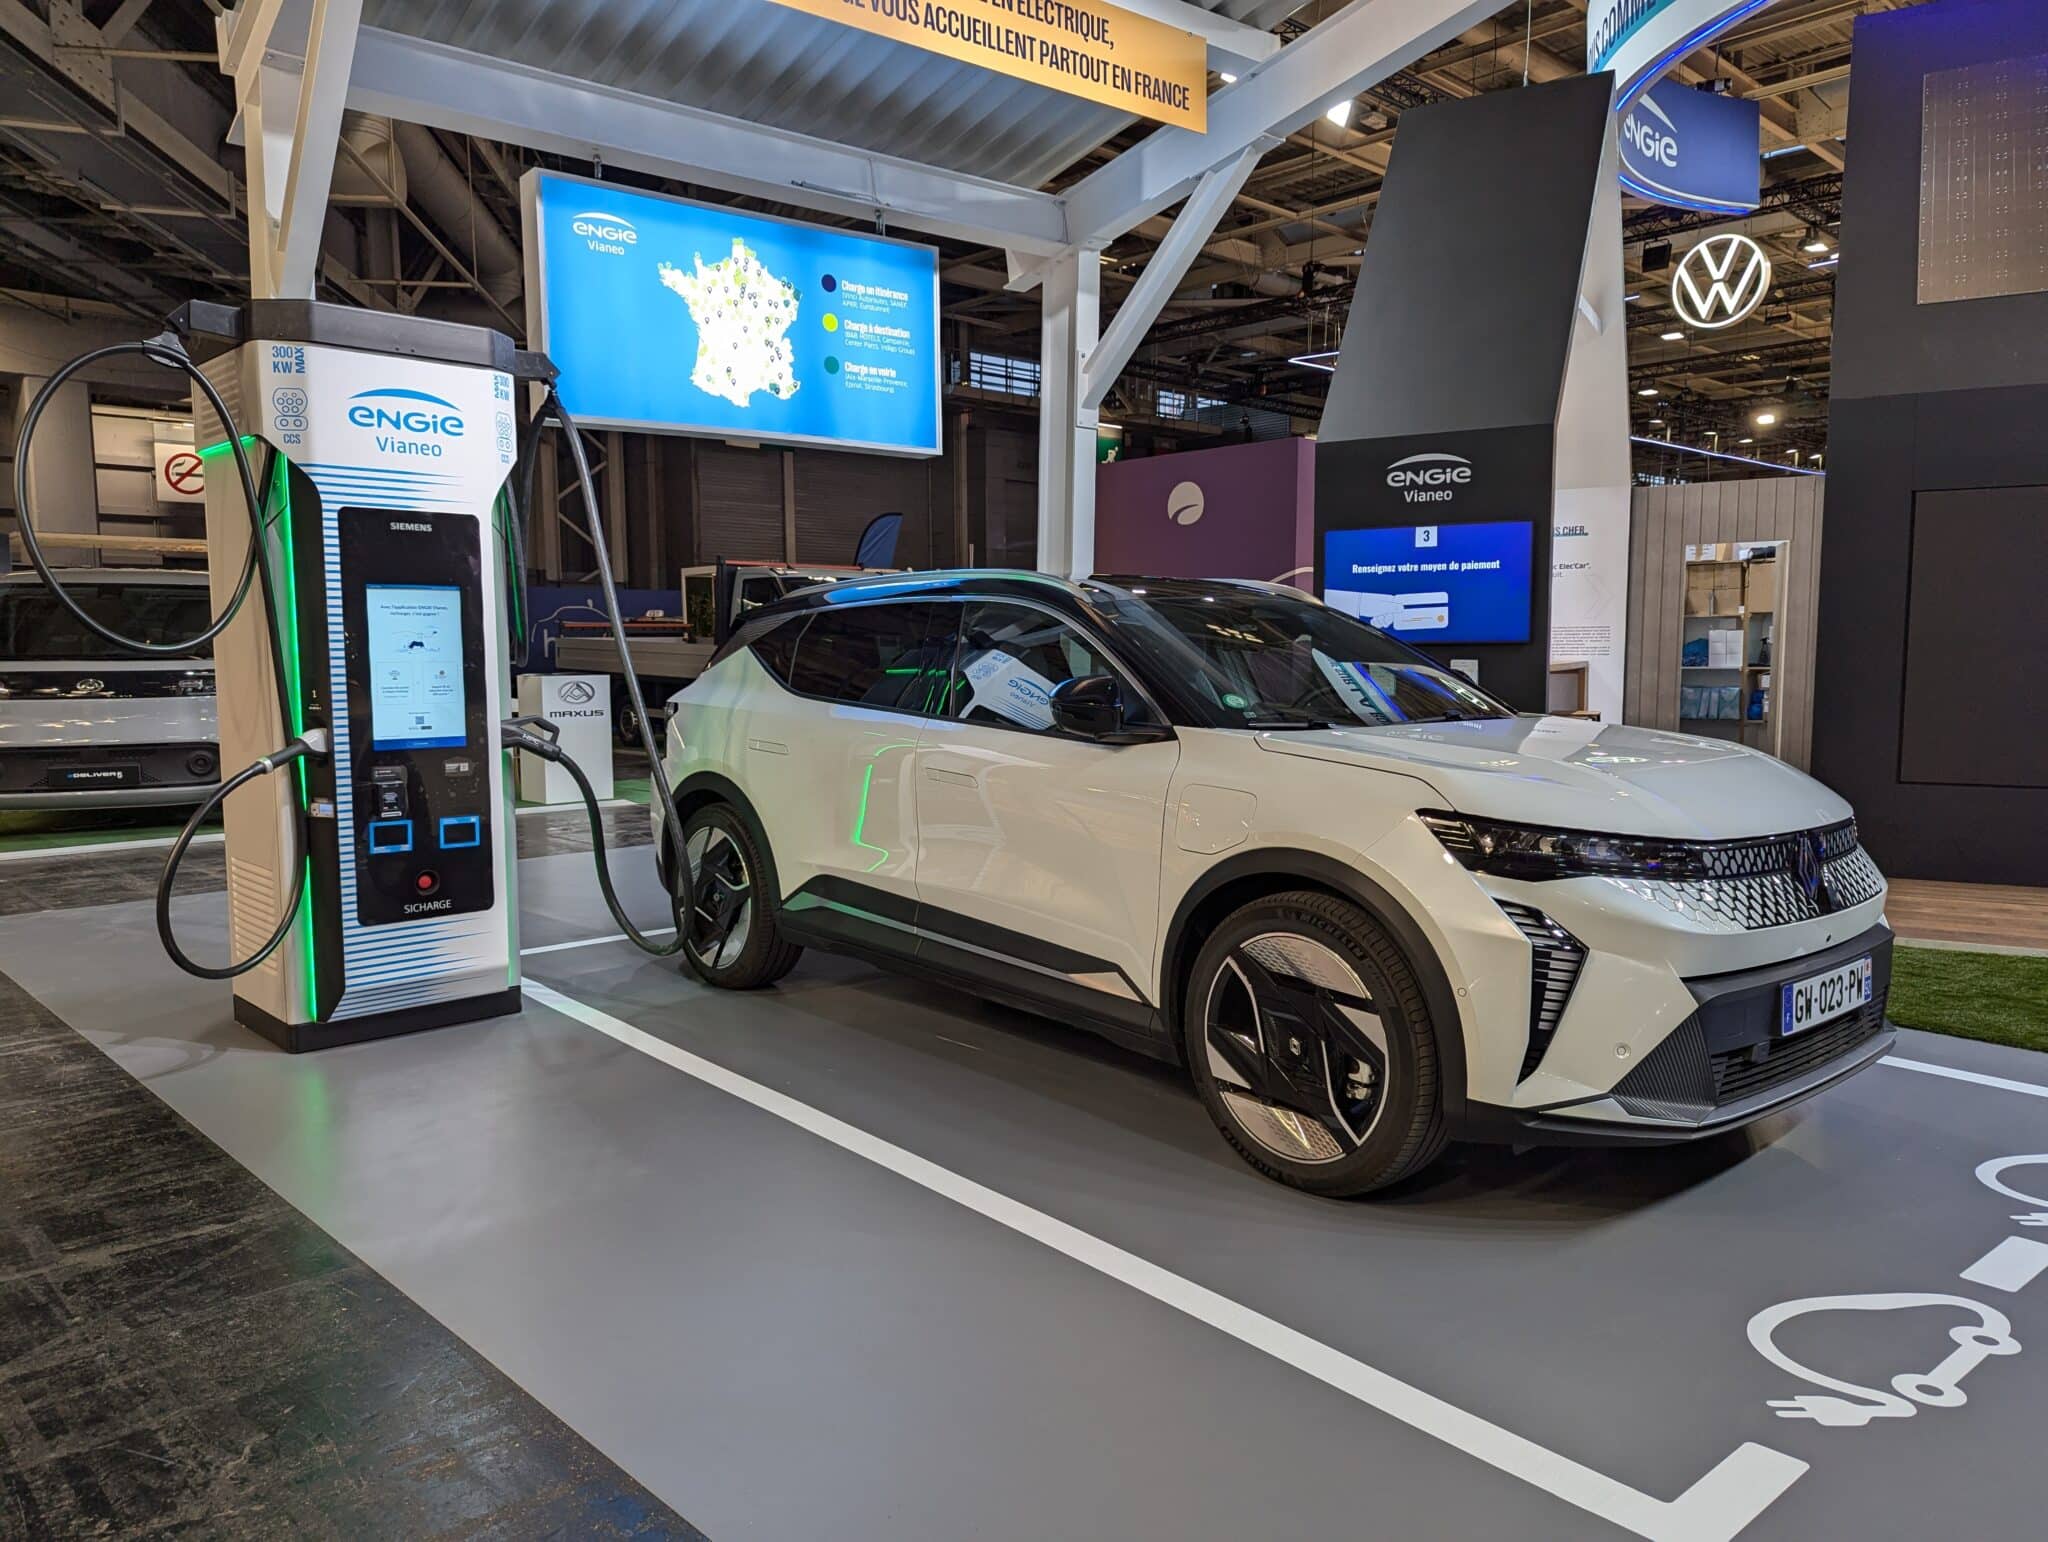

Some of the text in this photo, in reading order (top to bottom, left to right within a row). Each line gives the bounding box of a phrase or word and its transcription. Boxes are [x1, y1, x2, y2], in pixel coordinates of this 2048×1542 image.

[923, 2, 1037, 62] ACCUEILLENT
[1040, 40, 1110, 85] PARTOUT
[1113, 65, 1132, 93] EN
[1135, 72, 1190, 110] FRANCE
[587, 240, 625, 256] Vianeo
[272, 346, 294, 359] 300
[272, 360, 293, 374] KW
[294, 346, 305, 374] MAX
[283, 434, 302, 445] CCS
[375, 436, 442, 457] Vianeo
[1404, 490, 1453, 503] Vianeo
[390, 522, 433, 532] SIEMENS
[1423, 530, 1430, 542] 3
[1352, 559, 1500, 575] Renseignez votre moyen de paiement
[549, 709, 605, 718] MAXUS
[404, 900, 453, 914] SICHARGE
[1795, 965, 1864, 1024] GW-023-PW
